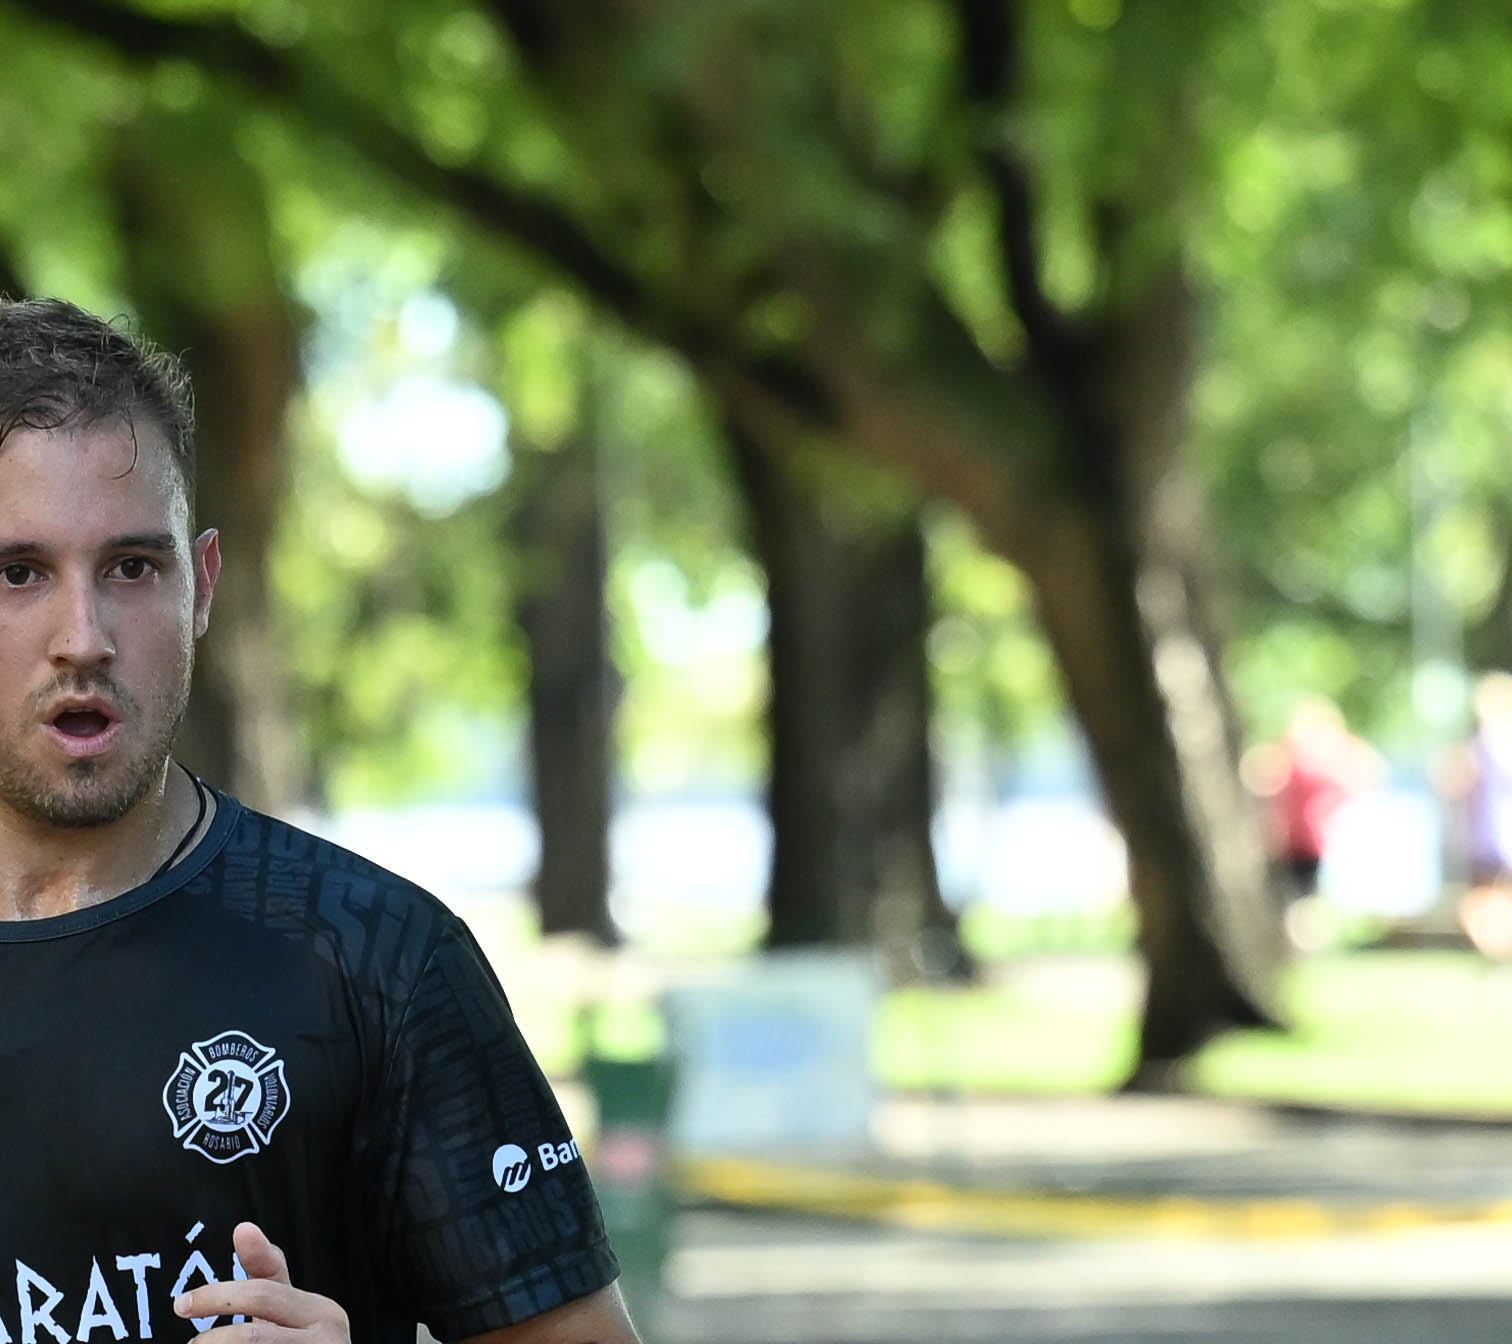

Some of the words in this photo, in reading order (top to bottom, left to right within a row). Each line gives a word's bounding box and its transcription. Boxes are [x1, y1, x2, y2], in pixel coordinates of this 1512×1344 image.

[208, 1042, 259, 1062] BOMBEROS
[204, 1068, 254, 1112] 27
[203, 1132, 241, 1150] ROSARIO
